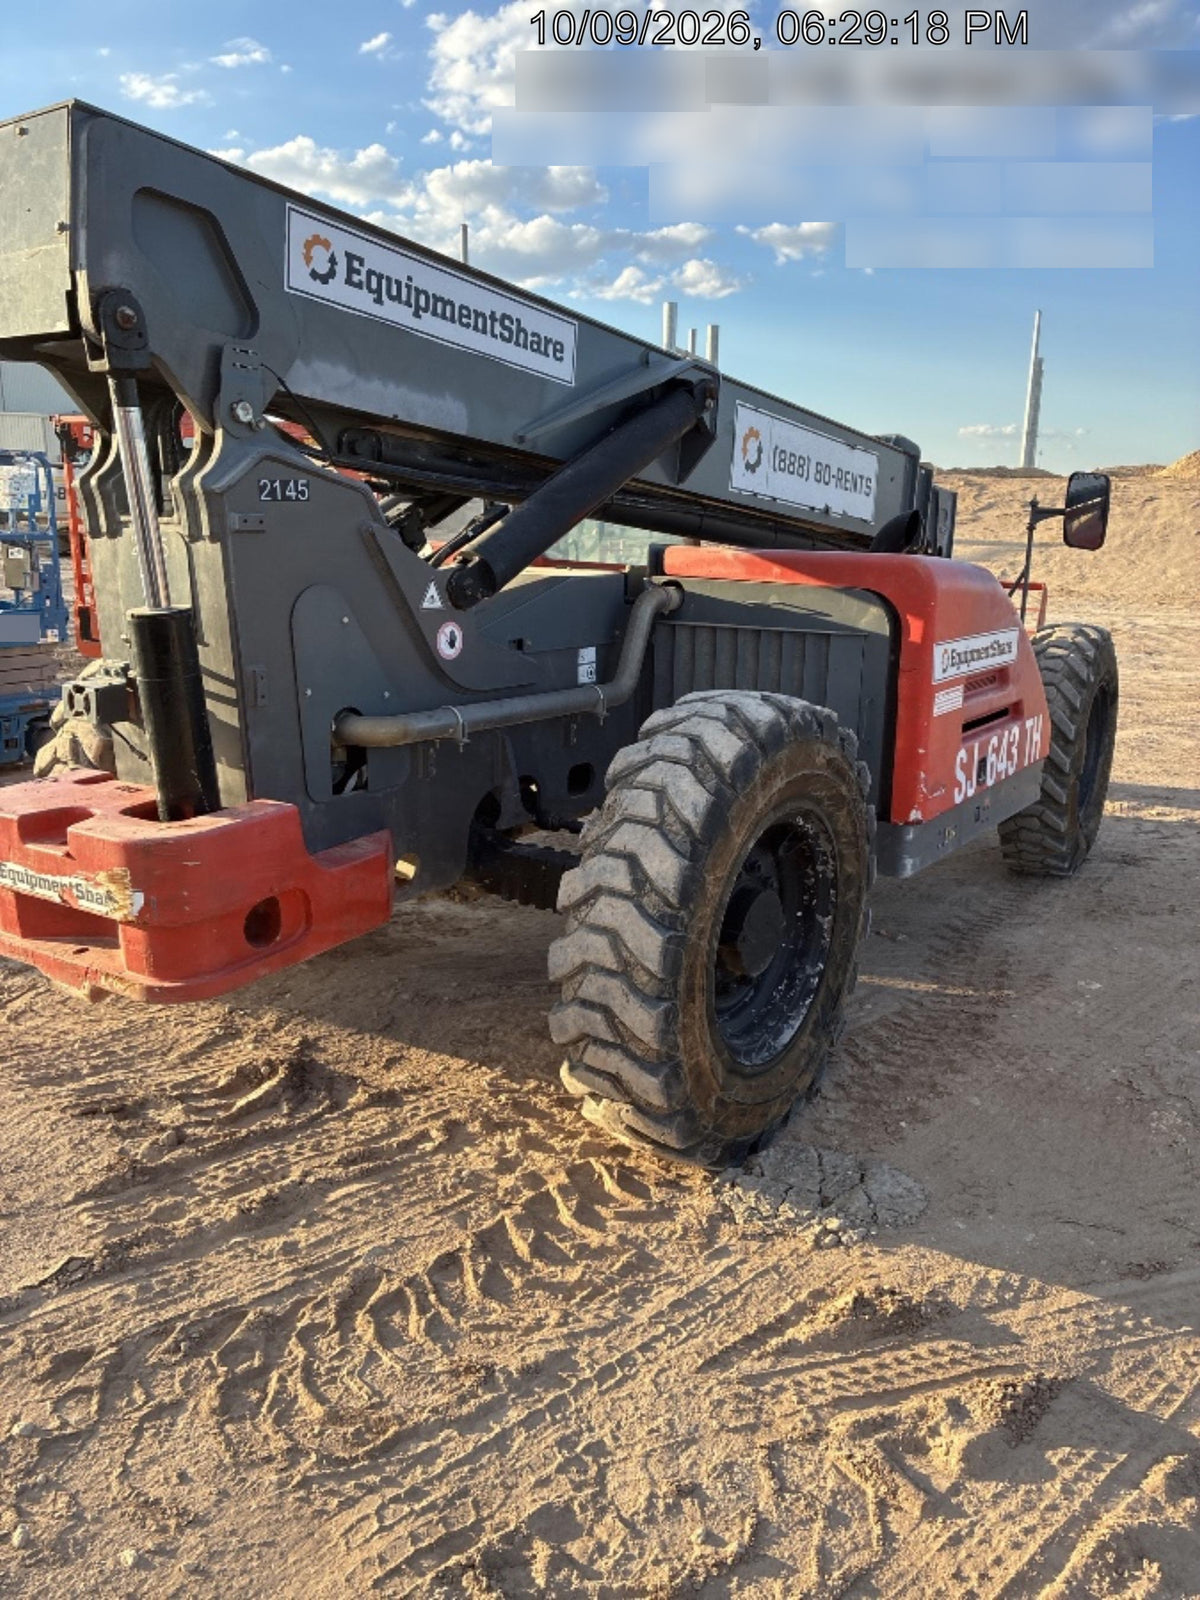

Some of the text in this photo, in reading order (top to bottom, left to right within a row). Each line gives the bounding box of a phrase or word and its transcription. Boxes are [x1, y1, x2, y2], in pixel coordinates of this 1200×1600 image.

[344, 250, 564, 363] EquipmentShare
[259, 479, 309, 500] 2145
[772, 445, 872, 497] (888) 80-RENTS
[954, 714, 1043, 804] SJ 643 TH
